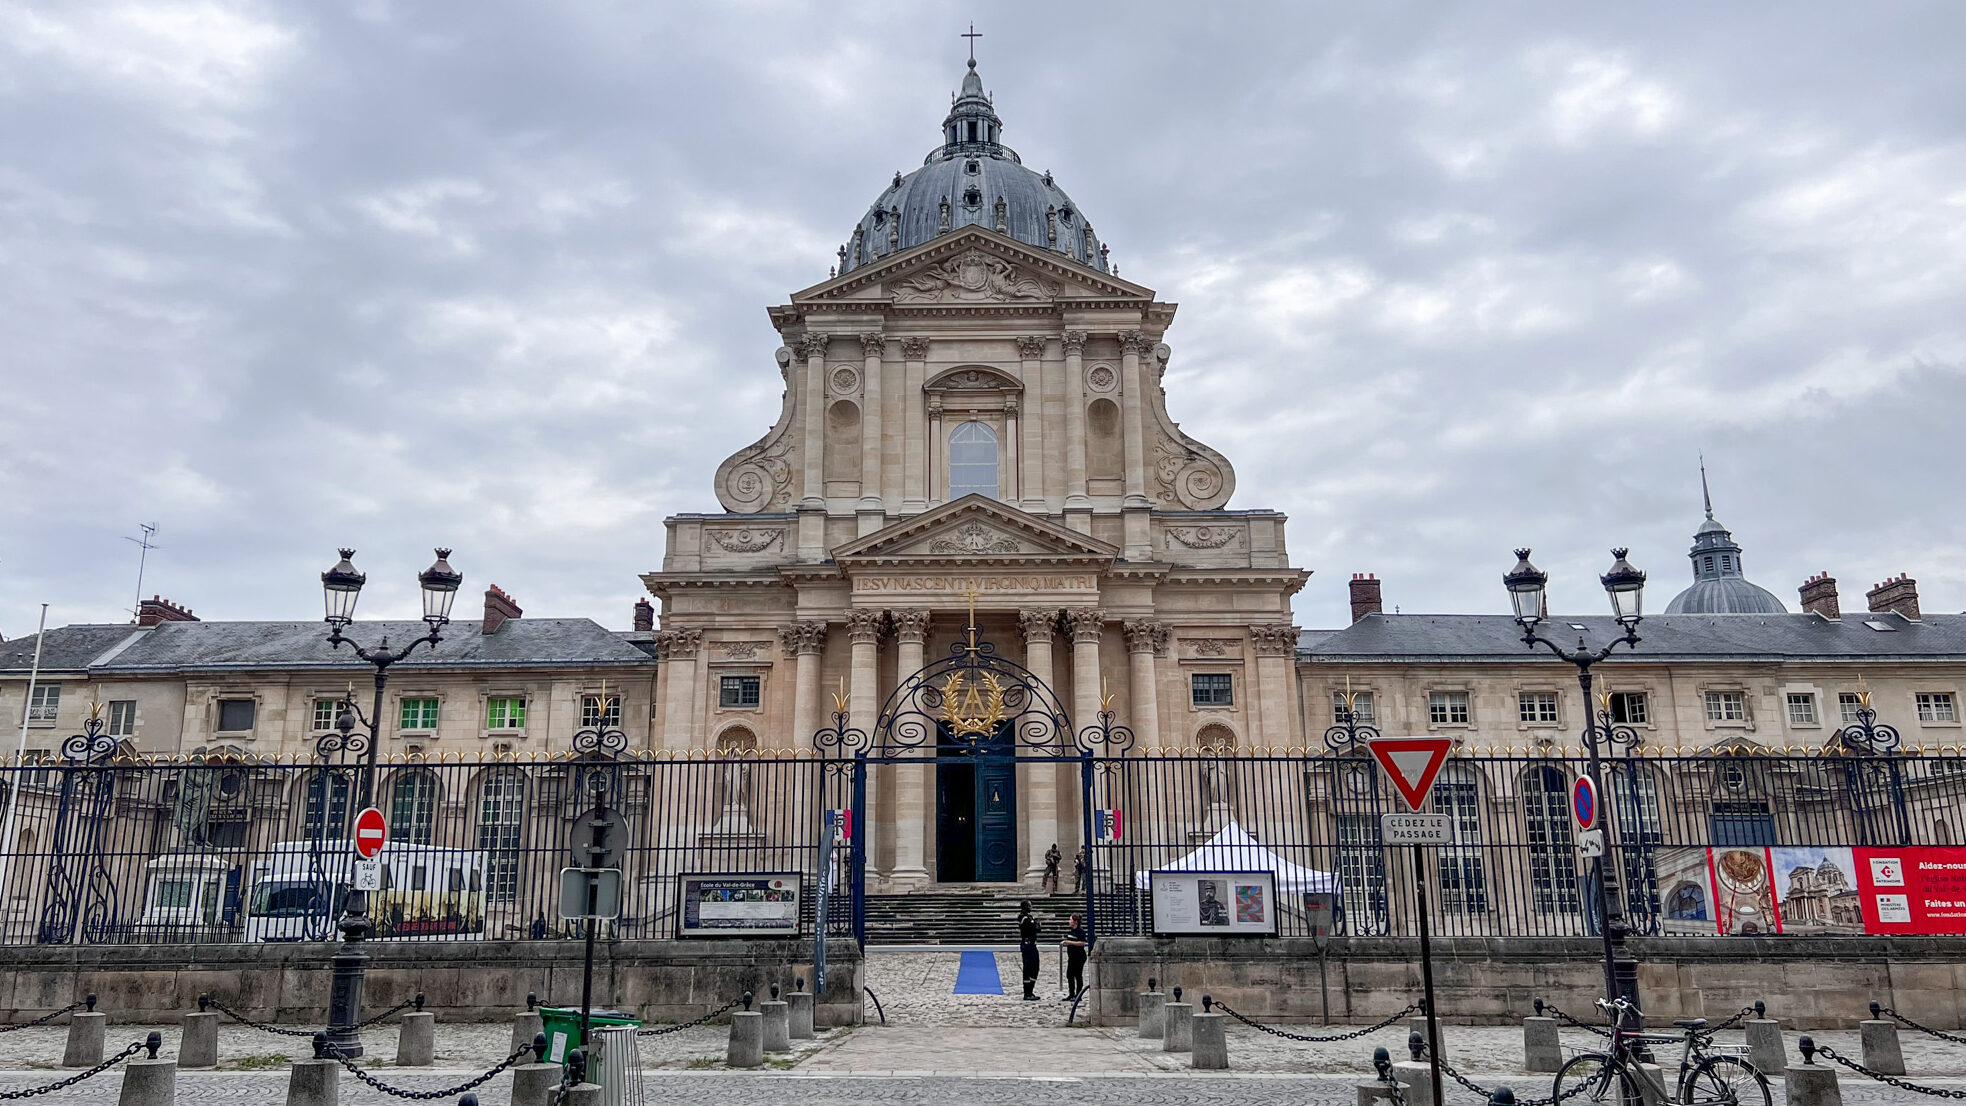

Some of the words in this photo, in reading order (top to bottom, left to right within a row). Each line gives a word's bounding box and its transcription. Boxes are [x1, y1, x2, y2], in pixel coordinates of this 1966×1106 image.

[1390, 818, 1425, 827] CÉDEZ
[1430, 819, 1442, 827] LE
[1393, 830, 1441, 838] PASSAGE
[362, 863, 376, 871] SAUF
[1925, 899, 1952, 908] Faites
[1954, 900, 1966, 908] un
